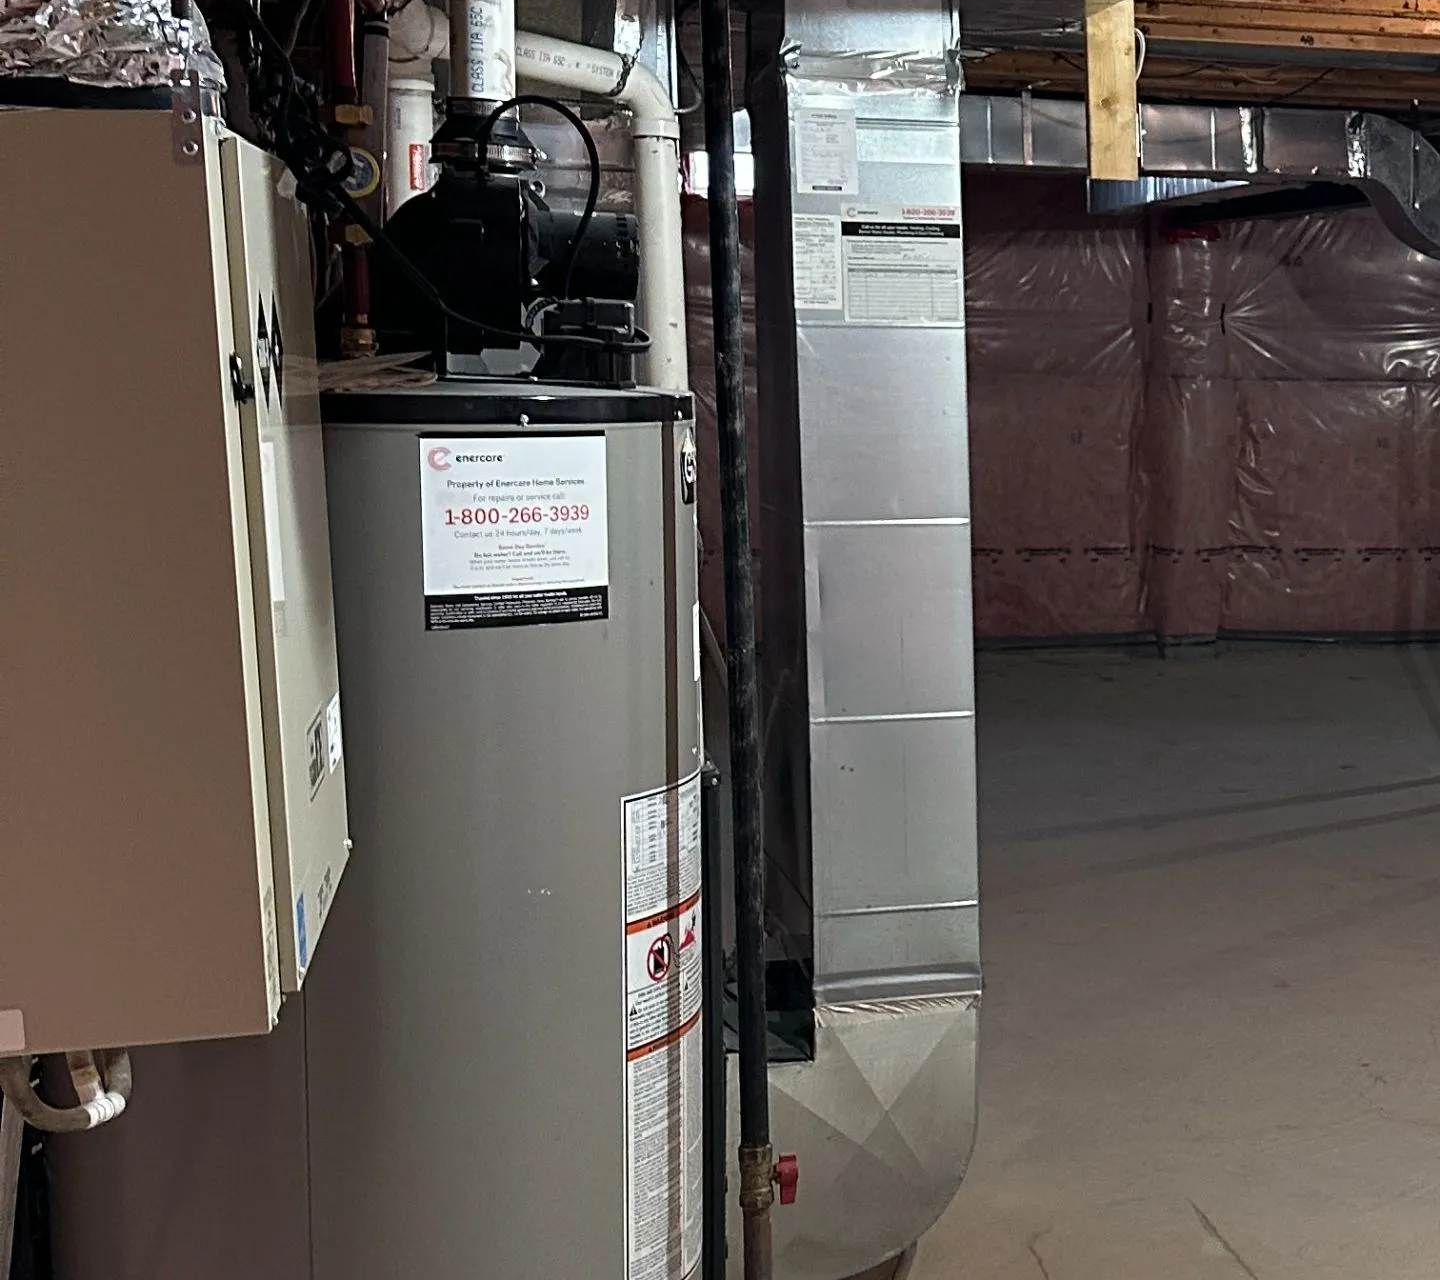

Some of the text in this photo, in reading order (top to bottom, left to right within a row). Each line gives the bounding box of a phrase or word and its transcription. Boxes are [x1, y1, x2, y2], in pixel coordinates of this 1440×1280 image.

[471, 60, 484, 93] CLASS
[455, 452, 504, 463] enercare
[446, 479, 483, 489] Property
[486, 480, 494, 488] of
[496, 479, 530, 487] Enercare
[473, 493, 486, 502] For
[444, 505, 590, 526] 1-800-266-3939
[454, 528, 483, 539] Contact
[495, 528, 505, 537] 24
